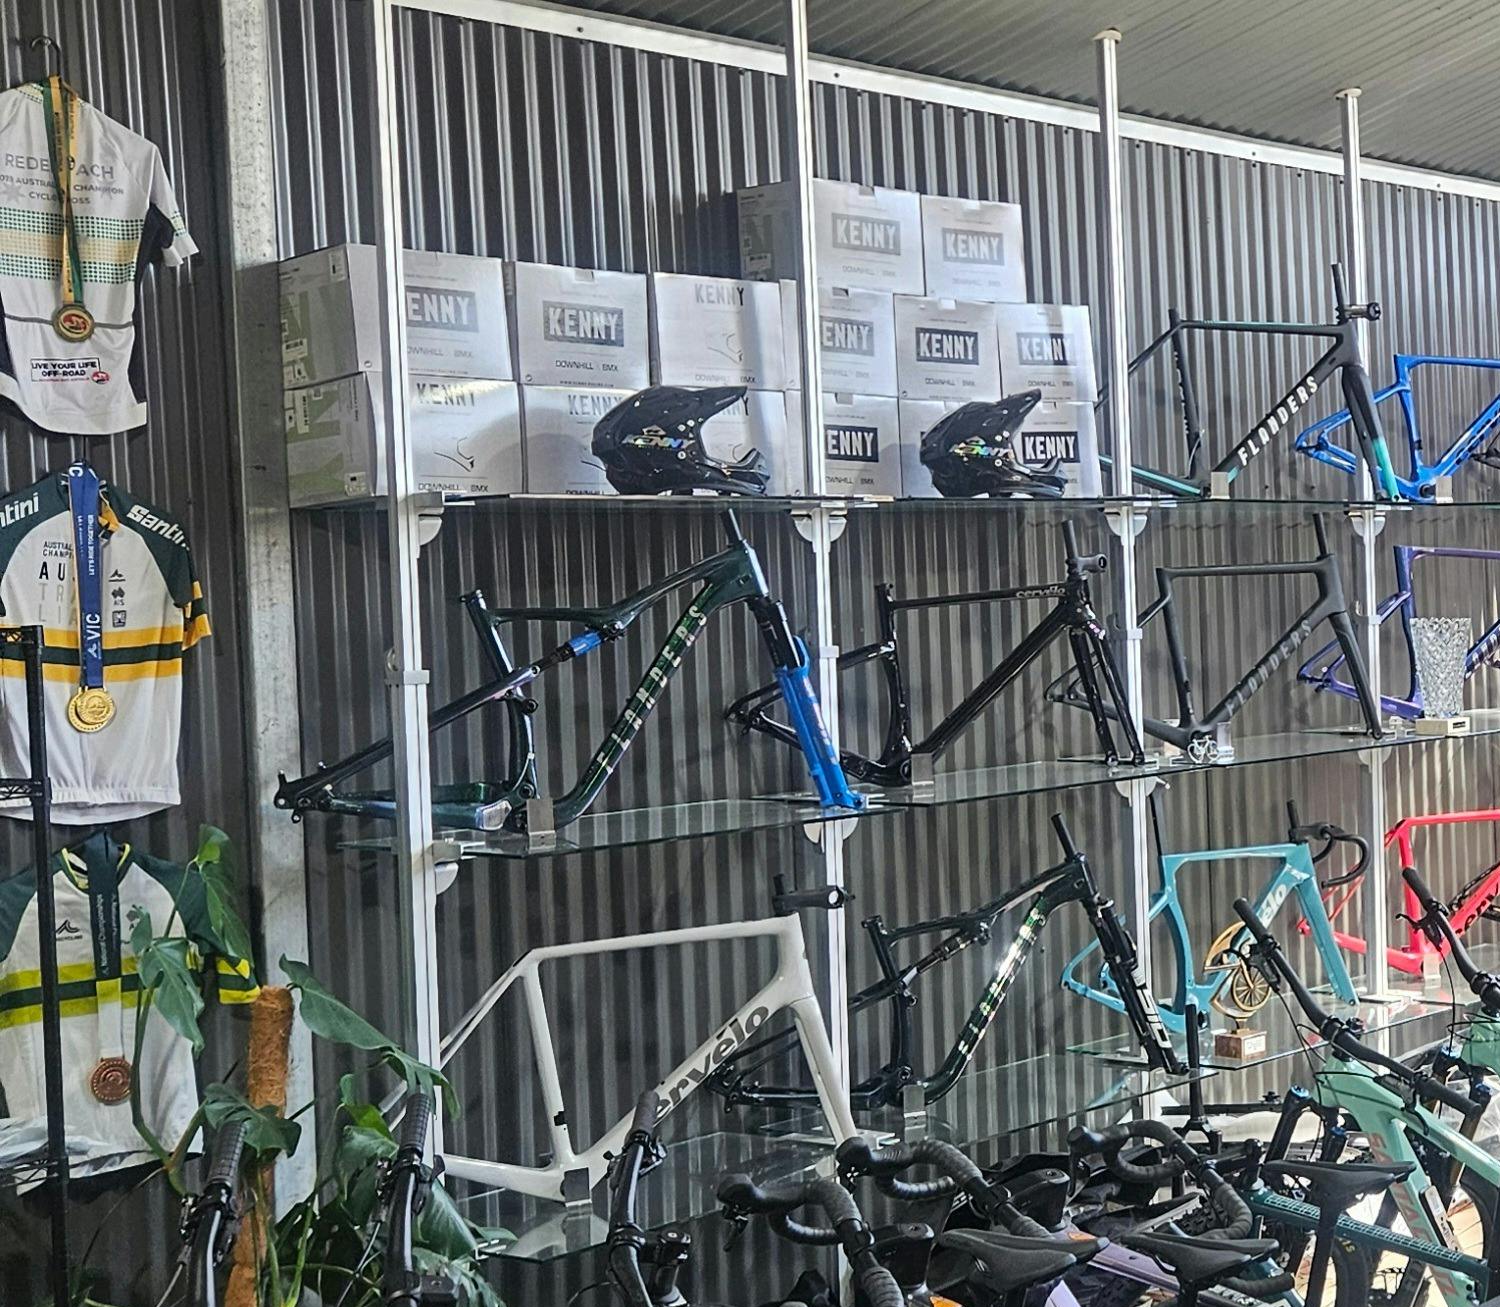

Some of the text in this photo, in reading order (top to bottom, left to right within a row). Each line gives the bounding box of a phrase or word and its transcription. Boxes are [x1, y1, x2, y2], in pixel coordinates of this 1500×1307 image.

[5, 153, 114, 179] REDEACH
[836, 219, 897, 249] KENNY
[946, 233, 1001, 260] KENNY
[695, 283, 745, 306] KENNY
[406, 292, 470, 325] ENNY
[549, 307, 620, 341] KENNY
[823, 322, 873, 350] ENNY
[919, 334, 976, 360] KENNY
[1021, 337, 1073, 363] KENNY
[32, 362, 49, 370] LIVE
[51, 361, 76, 369] YOUR
[555, 360, 619, 372] DOWNHILL BMX
[416, 383, 476, 407] KENNY
[1237, 375, 1319, 467] FLANDERS
[827, 430, 878, 456] ENNY
[1025, 437, 1076, 463] KENNY
[418, 483, 489, 493] DOWNHILL BMX
[86, 613, 100, 640] VIC
[1226, 618, 1313, 717] FLANDERS
[597, 605, 708, 773] FLANDERS
[655, 1006, 769, 1122] ervélo
